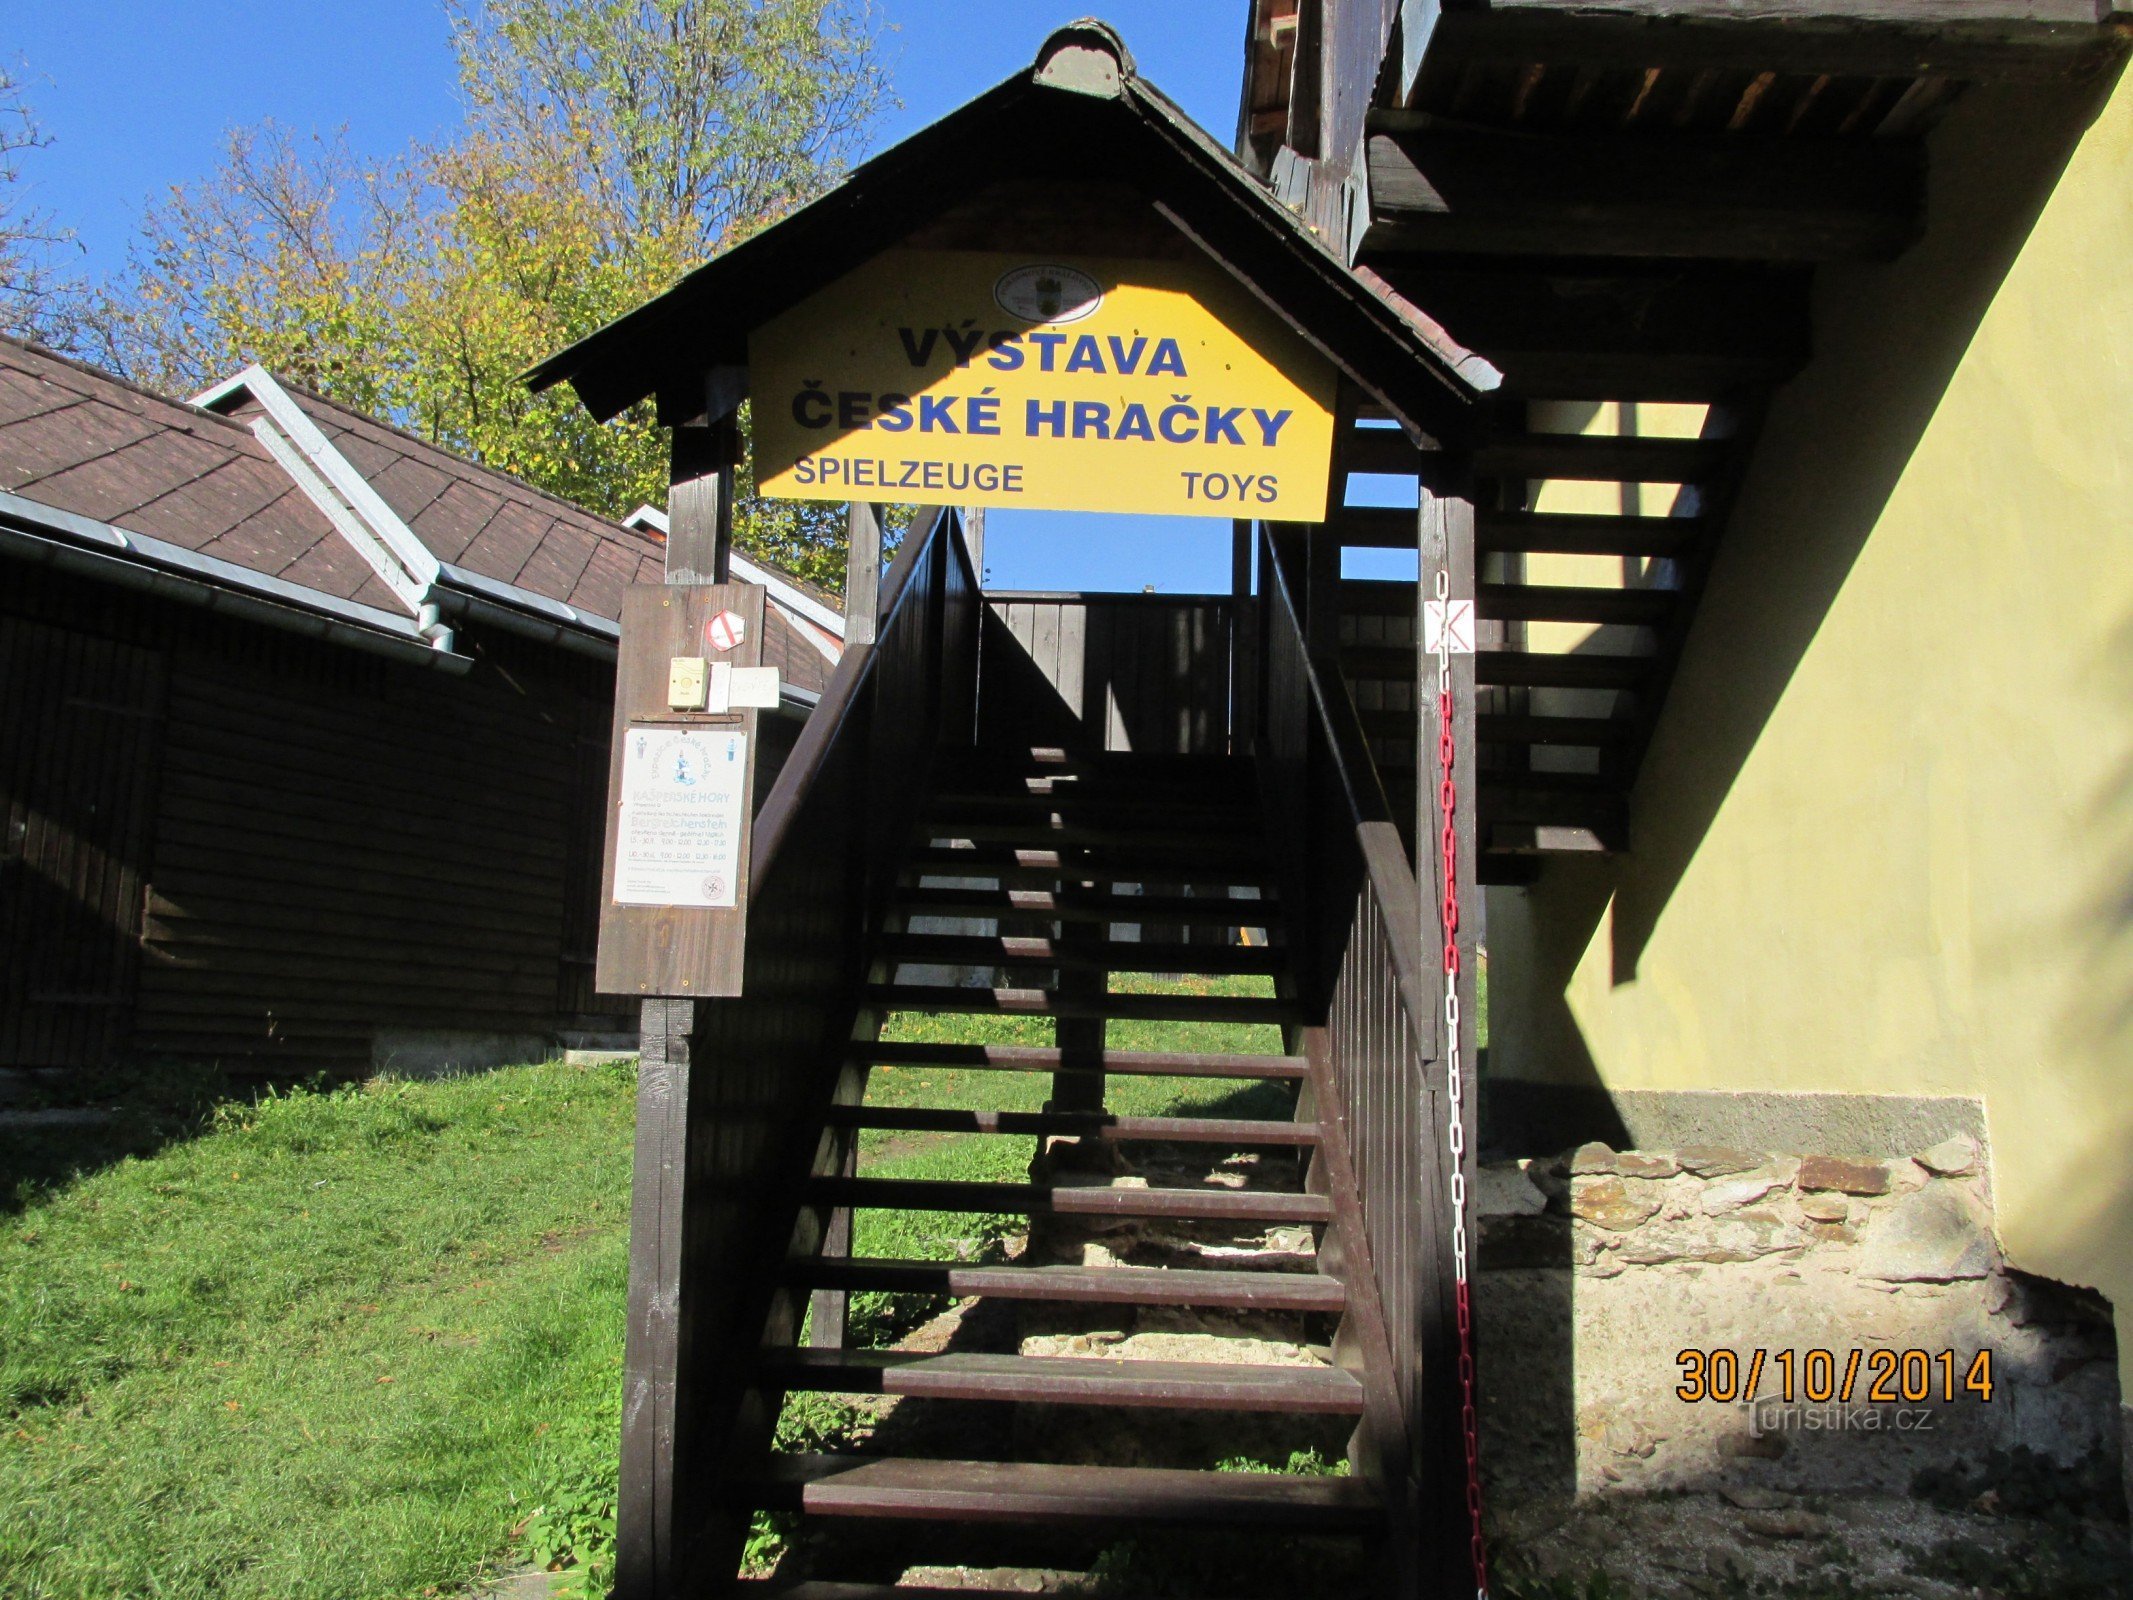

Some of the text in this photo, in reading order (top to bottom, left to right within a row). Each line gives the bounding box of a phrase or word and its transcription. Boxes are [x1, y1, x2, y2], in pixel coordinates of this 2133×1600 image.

[899, 319, 1188, 377] VÝSTAVA
[792, 379, 1293, 447] ČESKÉ HRAČKY
[794, 456, 1278, 503] SPIELZEUGE TOYS
[632, 788, 730, 803] KAŠPERSKÉ HORY
[631, 817, 727, 829] Bergreichenstein
